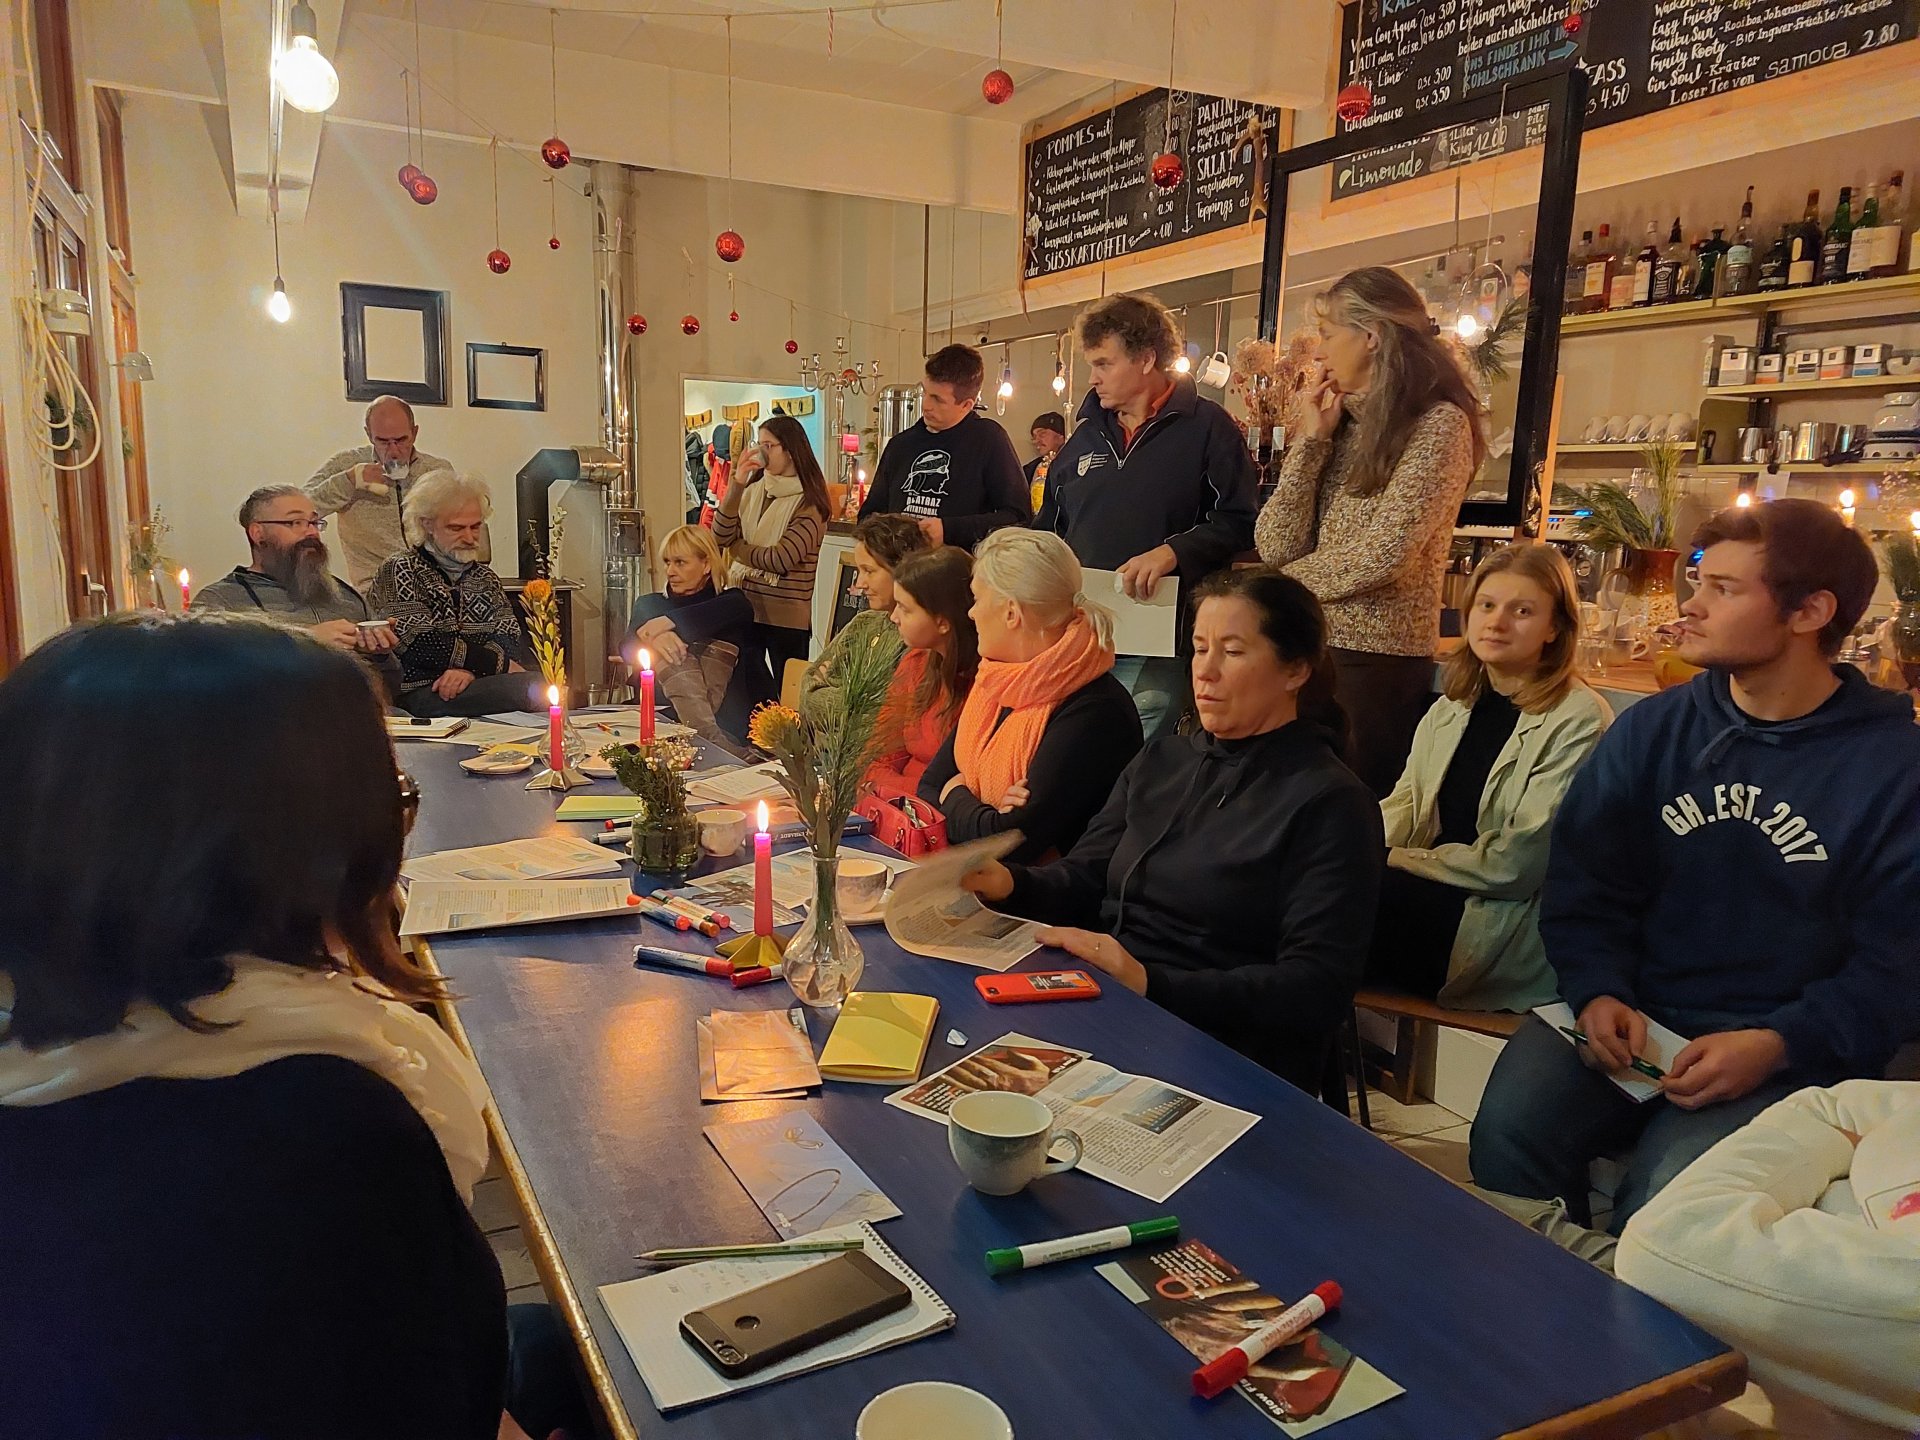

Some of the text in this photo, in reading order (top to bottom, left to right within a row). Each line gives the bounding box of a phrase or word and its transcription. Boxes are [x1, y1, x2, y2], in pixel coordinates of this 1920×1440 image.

[1392, 18, 1419, 45] Agua
[1484, 24, 1508, 46] auch
[1508, 3, 1569, 36] alkoholfrei
[1652, 18, 1681, 37] Easy
[1682, 4, 1725, 26] Friesy
[1349, 51, 1378, 76] LAUT
[1436, 19, 1456, 40] 6,00
[1487, 38, 1526, 66] FINDET
[1529, 29, 1551, 53] IHR
[1650, 48, 1689, 73] Fruity
[1691, 37, 1729, 64] Rooty
[1668, 87, 1708, 106] Loser
[1709, 76, 1729, 95] Tee
[1732, 73, 1755, 88] von
[1860, 22, 1900, 50] 2,80
[1647, 75, 1670, 93] Gin
[1670, 63, 1703, 87] Soul
[1196, 98, 1239, 126] PANINI
[1527, 112, 1545, 126] Pils
[1046, 117, 1111, 160] POMMES mit
[1197, 148, 1234, 182] SALAT
[1351, 149, 1424, 188] Limonade
[1239, 190, 1250, 208] ab
[1024, 261, 1040, 278] oder
[1044, 233, 1130, 272] SÜSSKARTOFFEL
[1255, 1392, 1284, 1415] Slow
